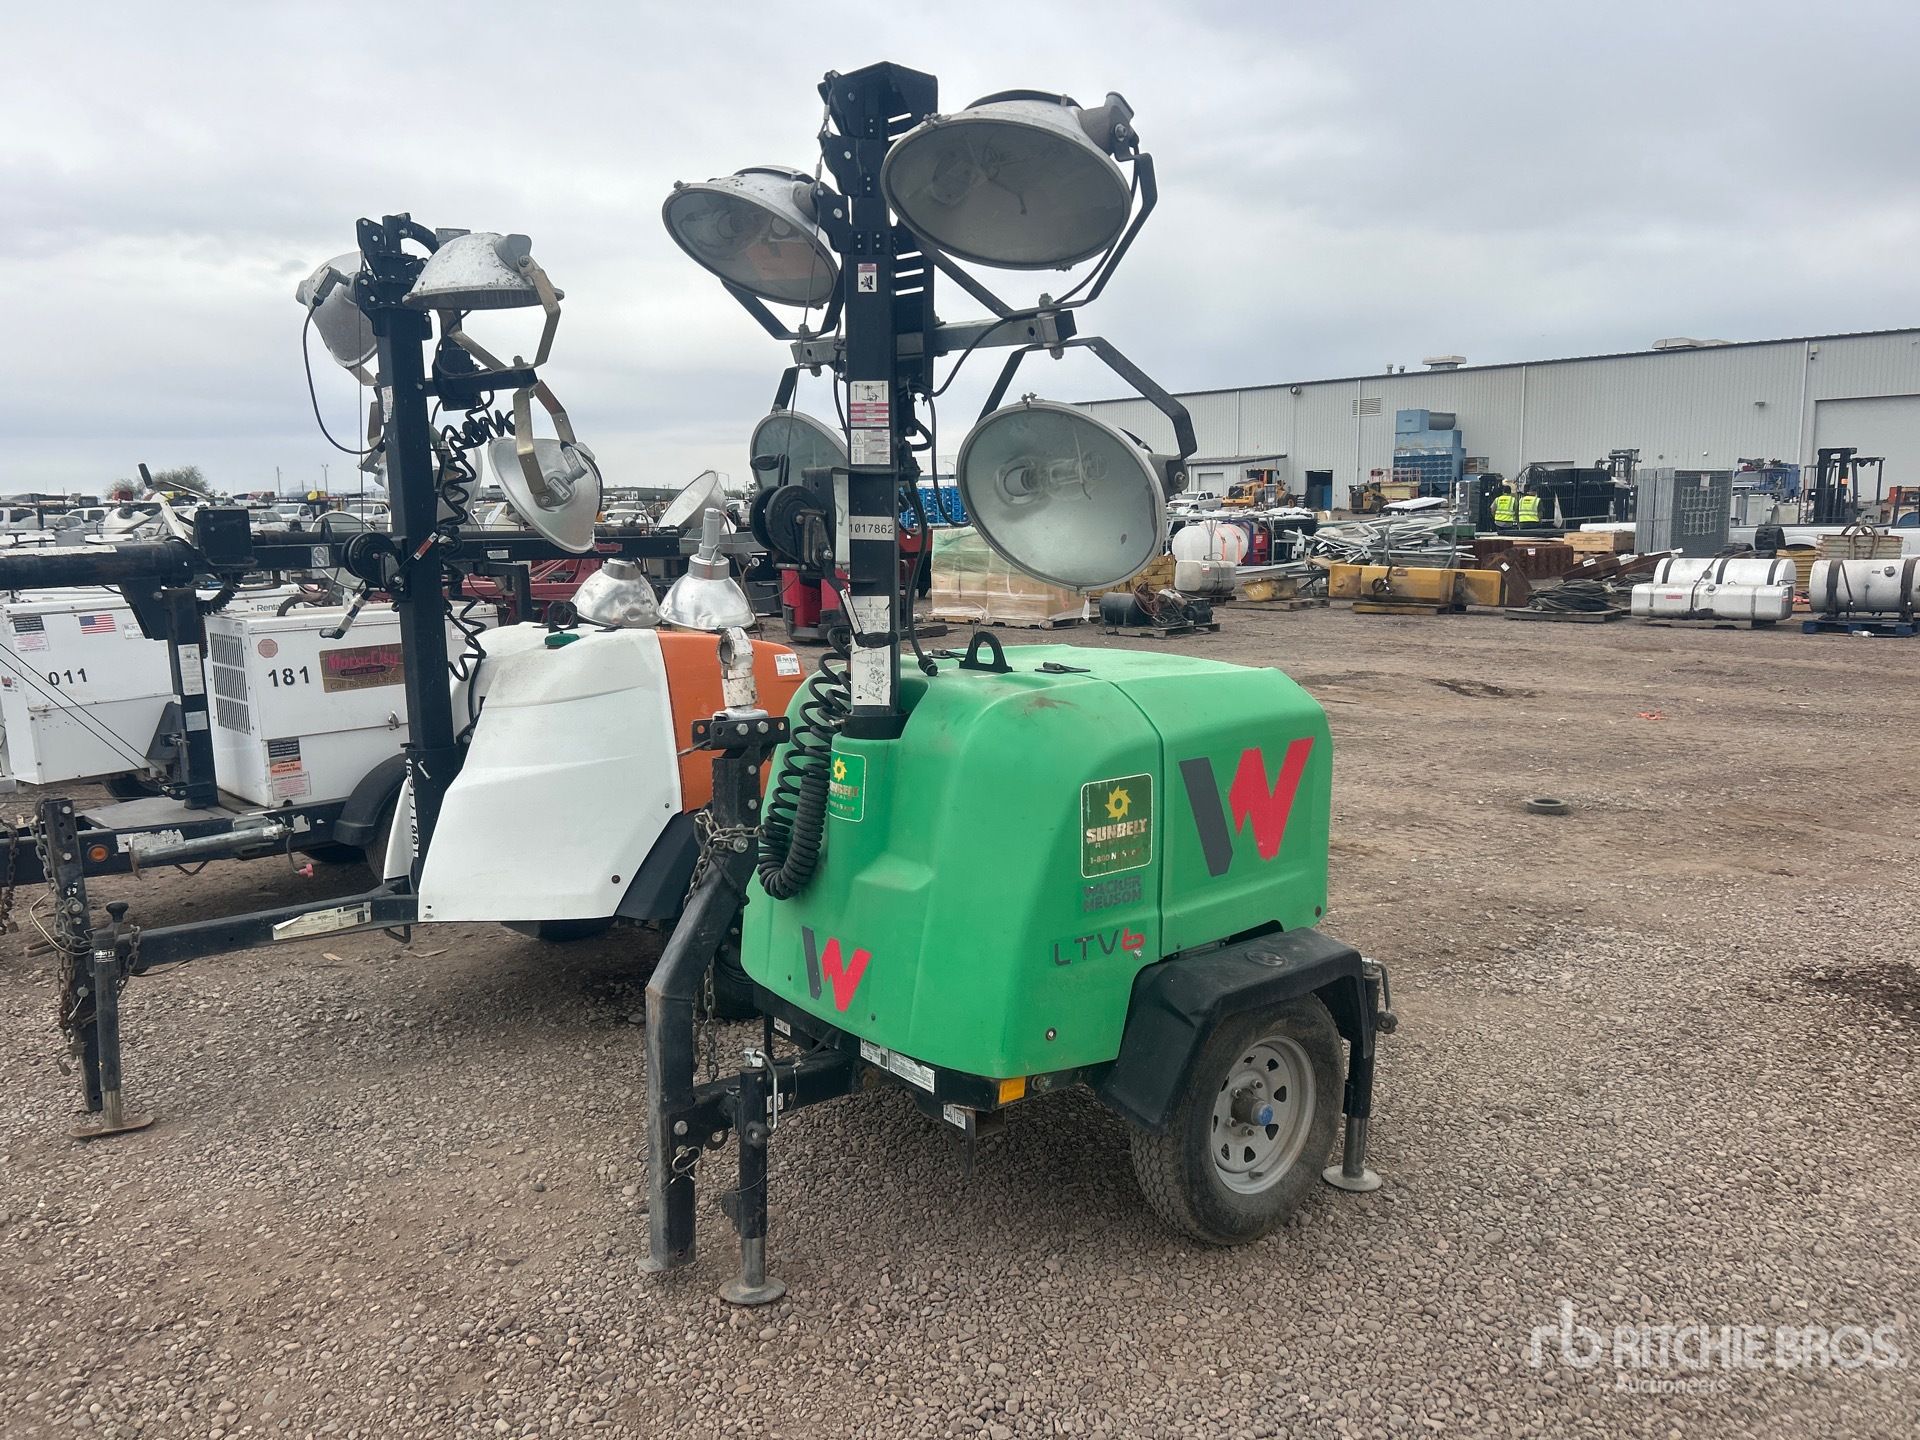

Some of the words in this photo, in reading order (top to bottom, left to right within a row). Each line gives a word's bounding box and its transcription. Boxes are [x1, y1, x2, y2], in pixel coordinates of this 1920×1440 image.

[849, 523, 893, 534] 1017862
[256, 603, 281, 611] Renta
[48, 667, 88, 686] 011
[268, 665, 310, 688] 181
[1086, 818, 1148, 845] SUNBELT
[1083, 874, 1142, 898] WACKER
[1083, 888, 1142, 913] NEUSON
[1054, 926, 1145, 966] LTV6
